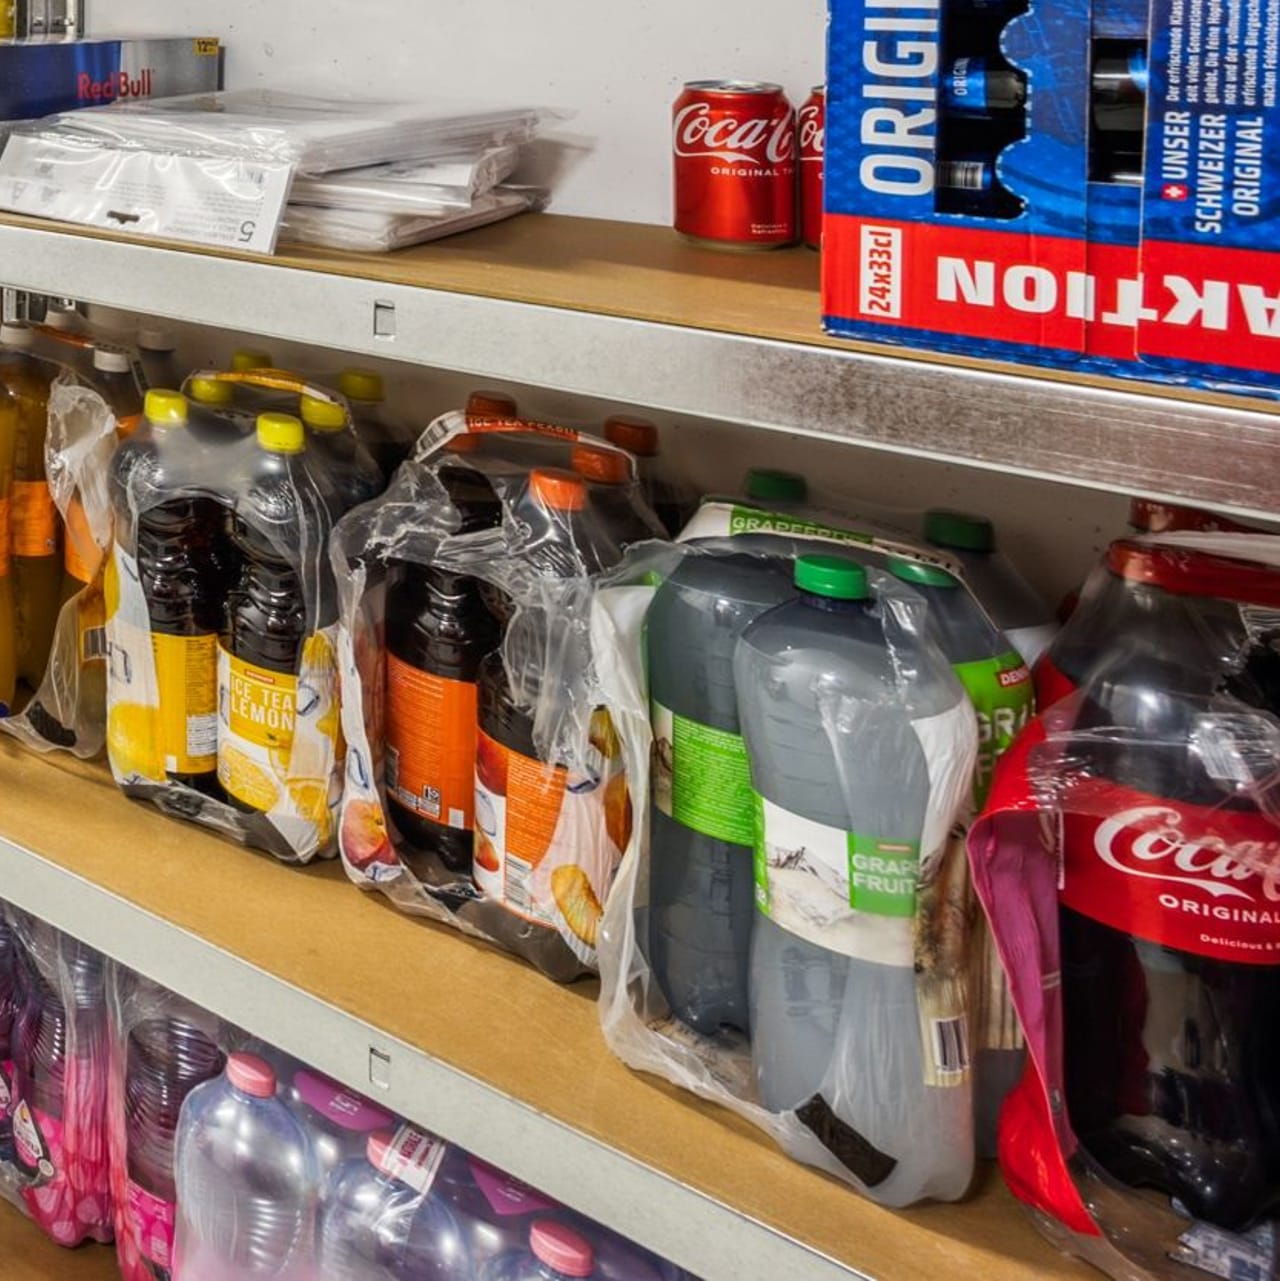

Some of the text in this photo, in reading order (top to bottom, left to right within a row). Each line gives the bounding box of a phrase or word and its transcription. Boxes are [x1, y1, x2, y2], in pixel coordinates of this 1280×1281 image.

[1207, 27, 1220, 50] feine
[1167, 28, 1182, 84] erfrischende
[1188, 55, 1199, 83] vielen
[1206, 53, 1219, 67] Die
[1227, 47, 1238, 62] der
[77, 68, 152, 98] Red Bull
[1206, 70, 1220, 103] geliebt.
[1226, 65, 1238, 81] und
[1244, 49, 1258, 106] erfrischende
[1166, 86, 1179, 101] Der
[1187, 85, 1198, 103] seit
[1226, 85, 1237, 104] note
[1263, 71, 1276, 106] machen
[1162, 111, 1191, 179] UNSER
[711, 166, 779, 177] ORIGINAL
[1195, 114, 1227, 233] SCHWEIZER
[1232, 117, 1264, 216] ORIGINAL
[868, 231, 892, 315] 24x33cl
[937, 256, 1280, 338] AKTION
[231, 675, 251, 701] ICE
[261, 688, 294, 712] TEA
[231, 694, 294, 731] LEMON
[853, 872, 917, 894] FRUIT
[1159, 894, 1280, 924] ORIGINAL
[1200, 933, 1262, 950] Delicious
